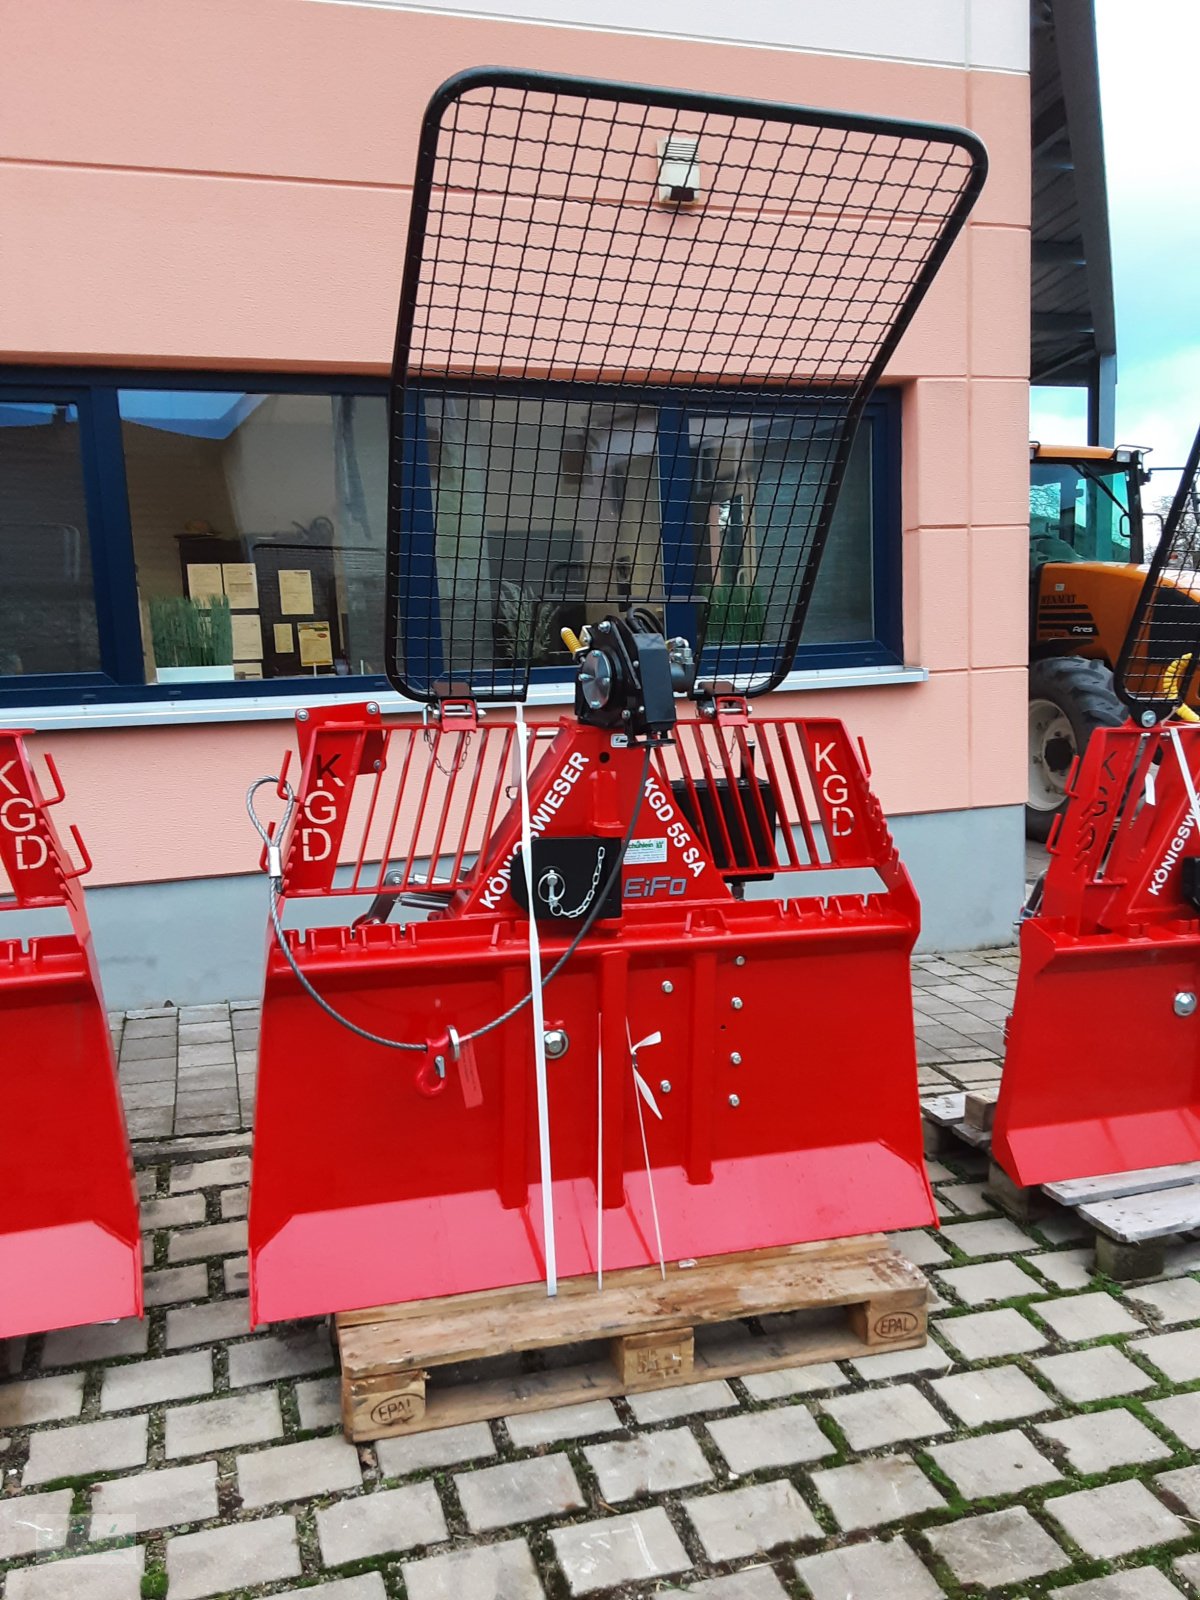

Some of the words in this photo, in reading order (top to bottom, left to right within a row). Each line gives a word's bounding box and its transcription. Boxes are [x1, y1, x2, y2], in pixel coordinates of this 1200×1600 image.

[303, 753, 346, 862] KGD
[479, 751, 590, 909] KÖNWIESER
[644, 777, 674, 822] KGD
[666, 822, 691, 848] 55
[682, 847, 706, 878] SA
[814, 742, 855, 836] KGD
[880, 1317, 912, 1335] EPAL
